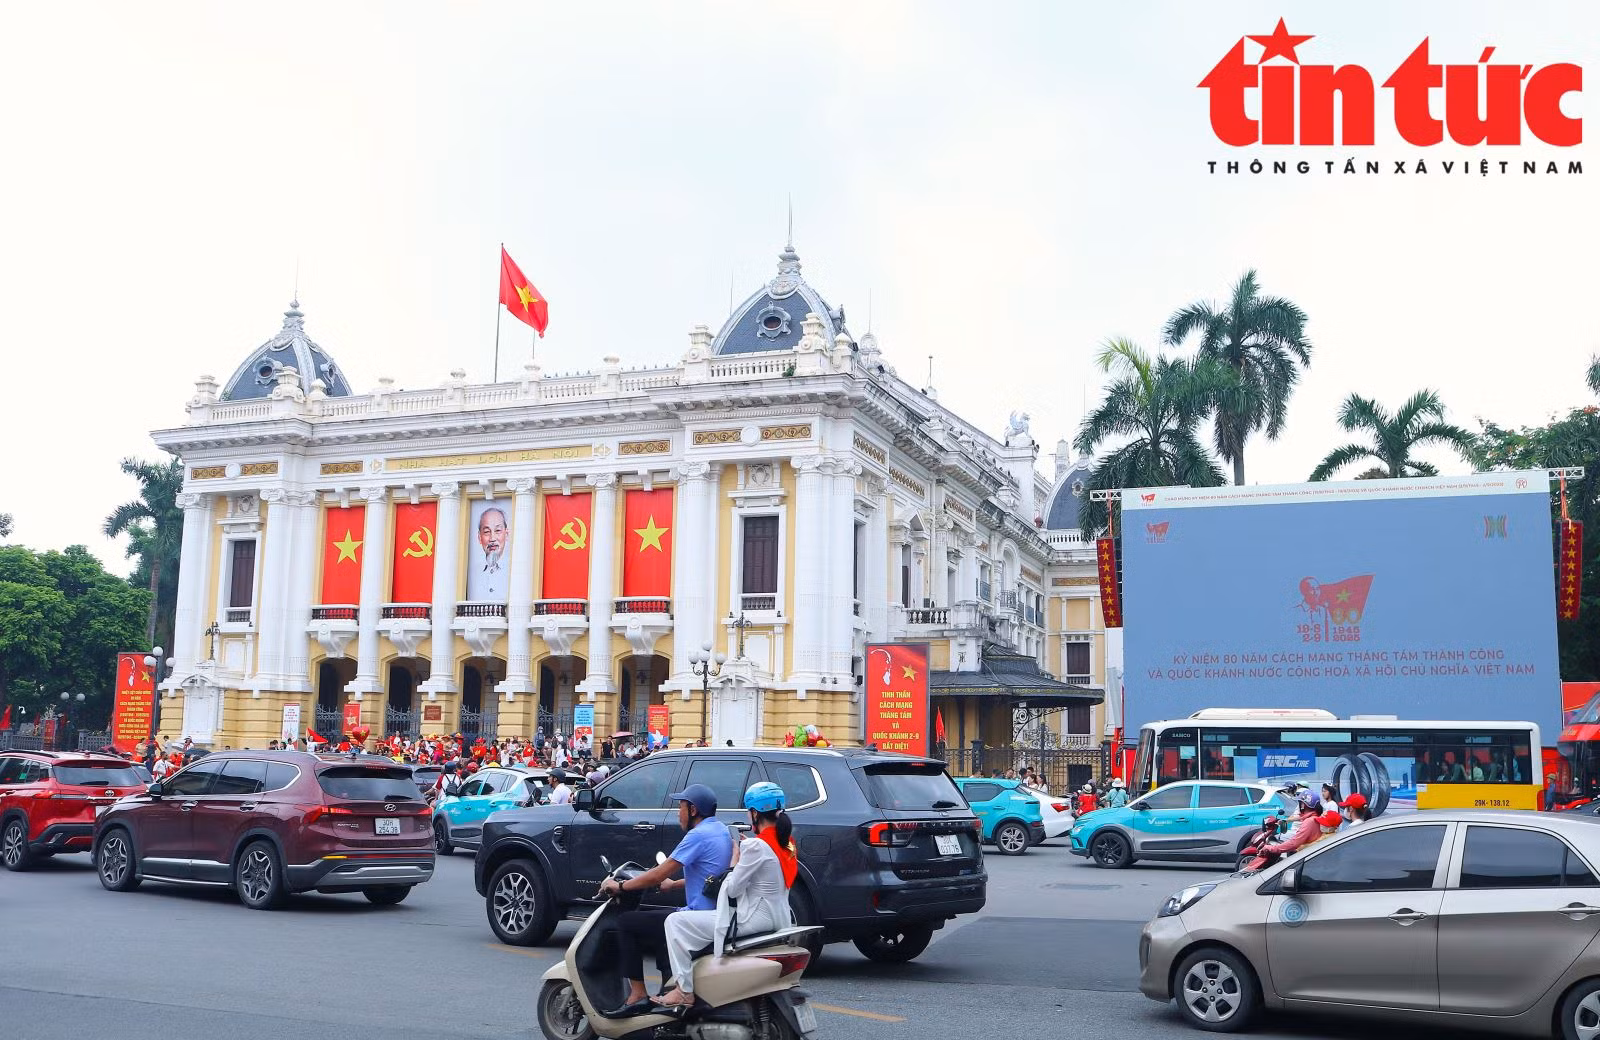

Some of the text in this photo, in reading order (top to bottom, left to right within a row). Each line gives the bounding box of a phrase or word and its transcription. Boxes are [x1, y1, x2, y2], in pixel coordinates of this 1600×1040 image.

[1223, 654, 1238, 664] 80
[1272, 651, 1304, 663] CÁCH
[1348, 650, 1388, 662] THÁNG
[1392, 649, 1418, 661] TÁM
[1422, 648, 1465, 660] THÀNH
[1470, 648, 1505, 660] CÔNG
[1204, 666, 1245, 678] KHÁNH
[1506, 664, 1535, 675] NAM
[1264, 755, 1298, 768] IRC
